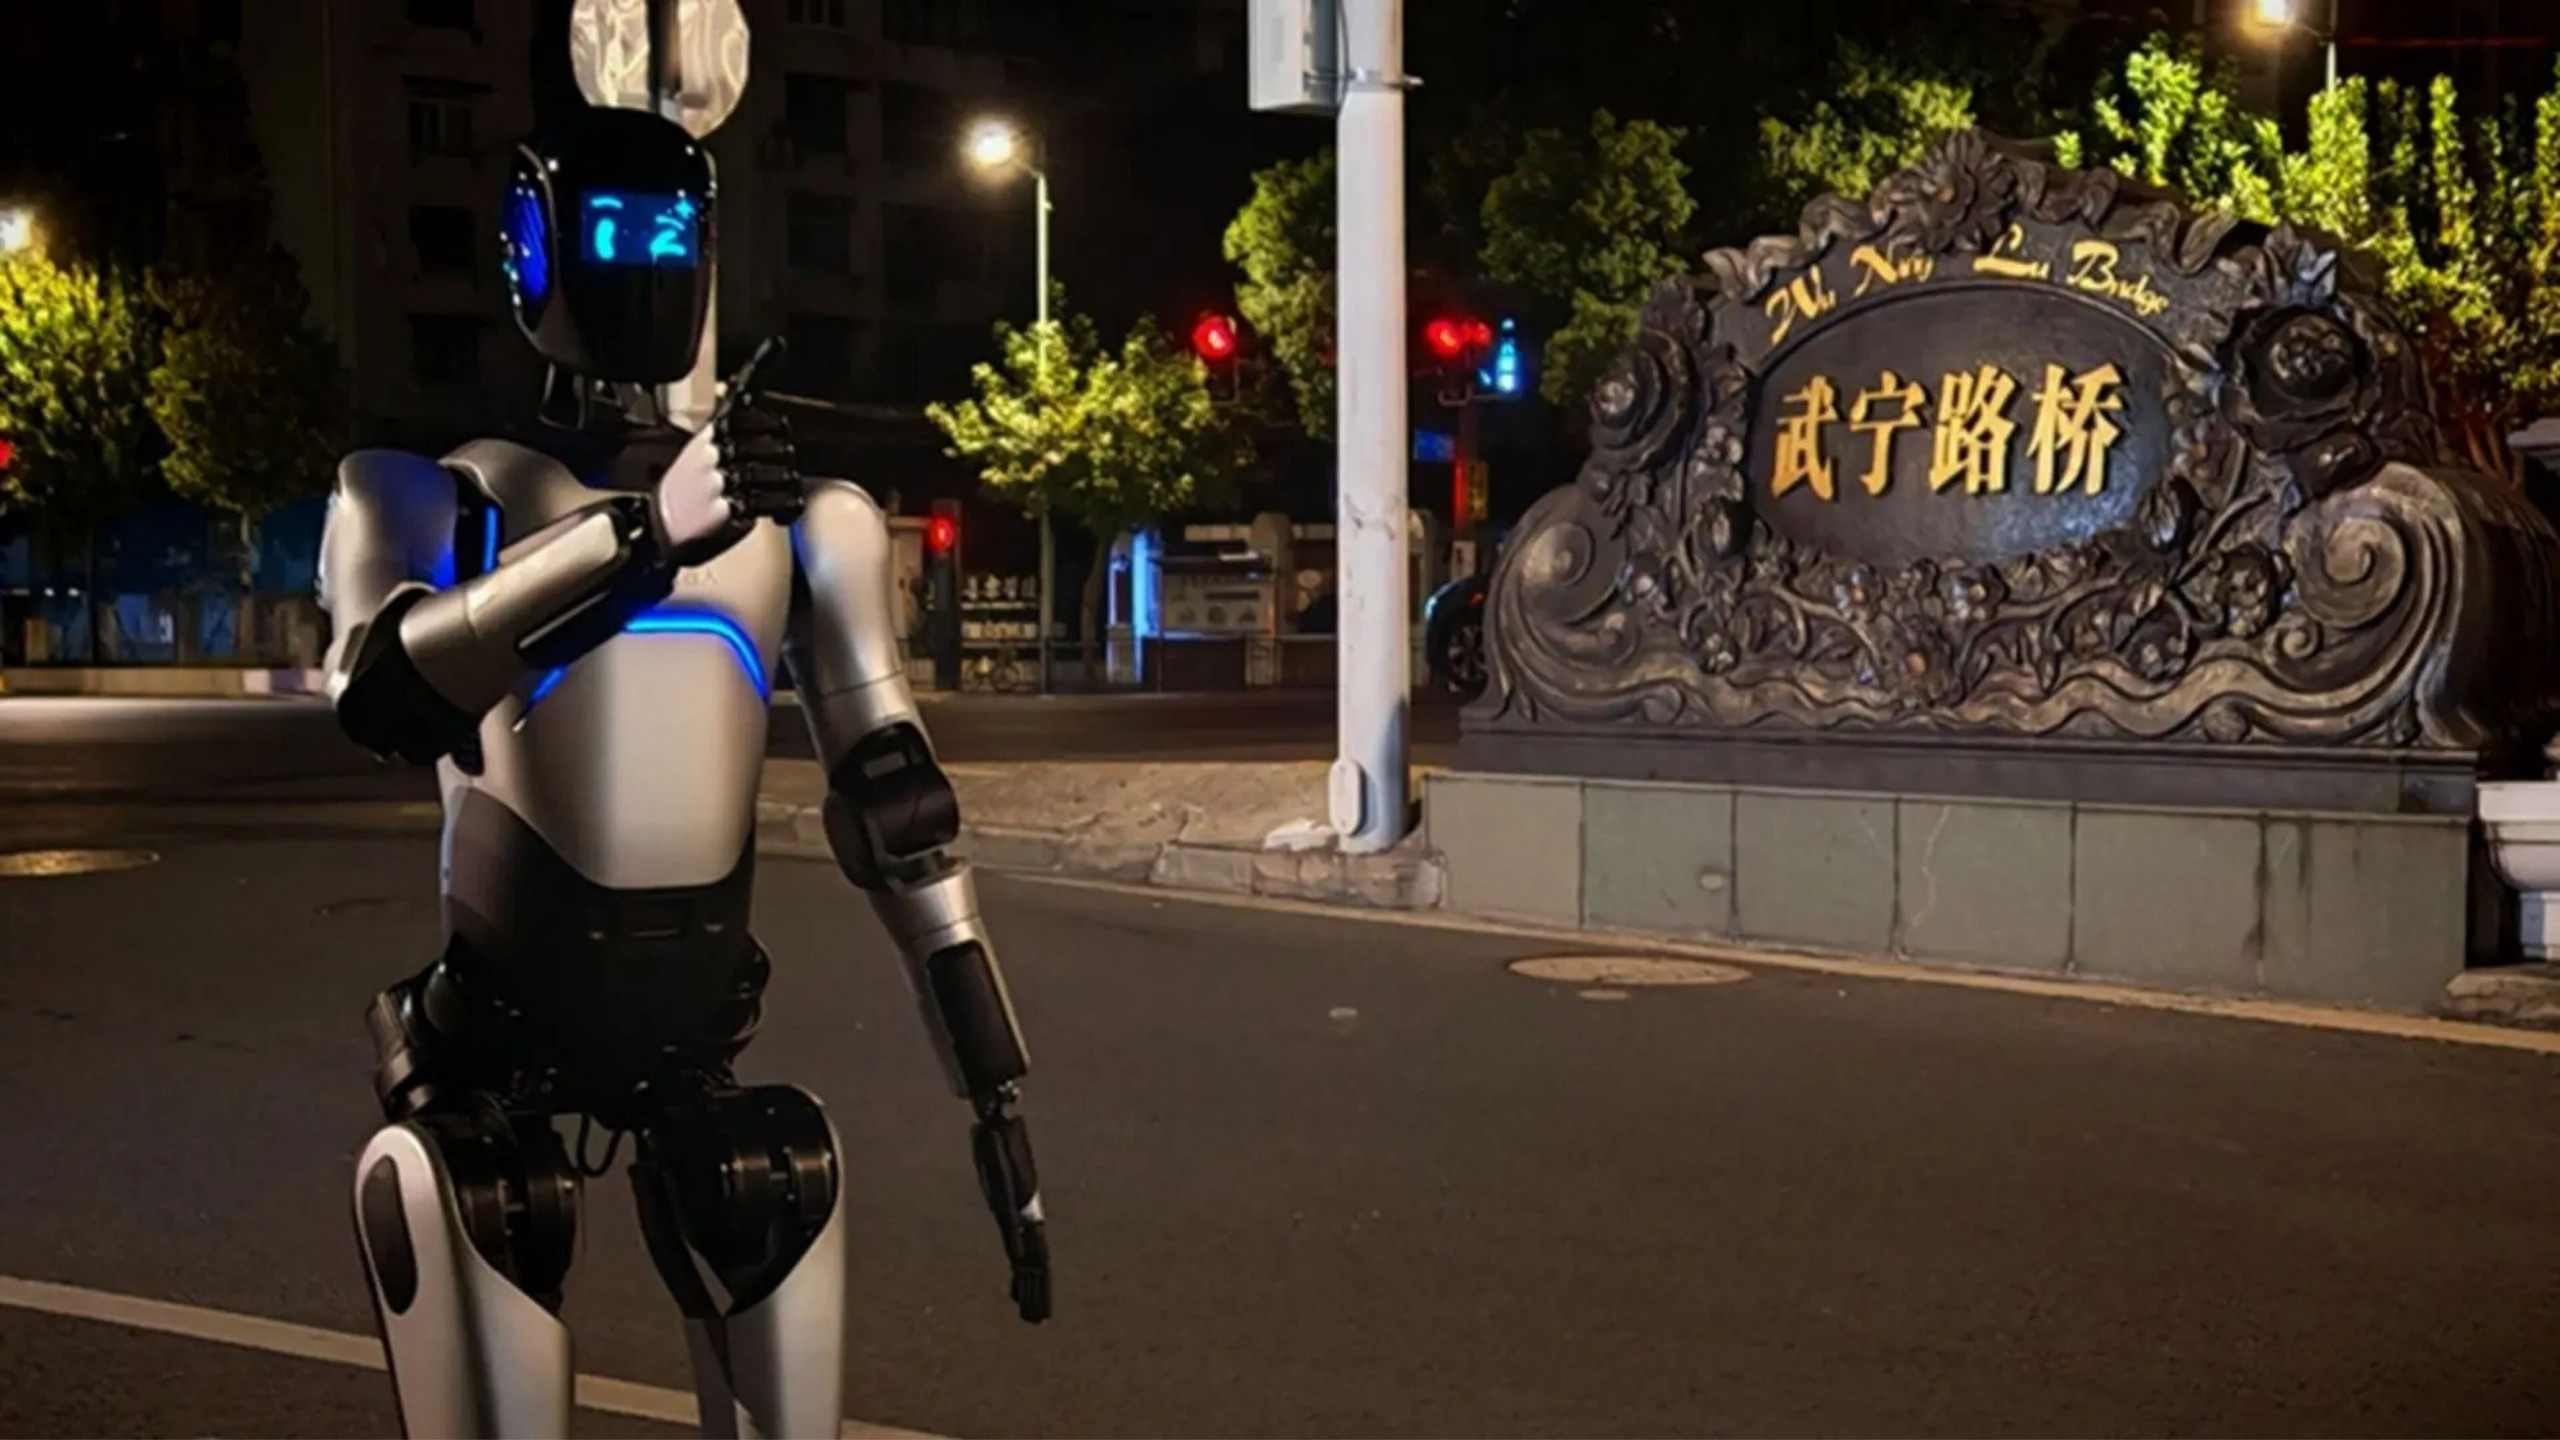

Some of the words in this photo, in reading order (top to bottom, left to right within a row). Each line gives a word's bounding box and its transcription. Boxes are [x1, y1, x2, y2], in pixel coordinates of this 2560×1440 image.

[1972, 222, 2050, 279] Lu
[2065, 238, 2170, 316] Bridge
[1771, 361, 2124, 501] 武宁路桥
